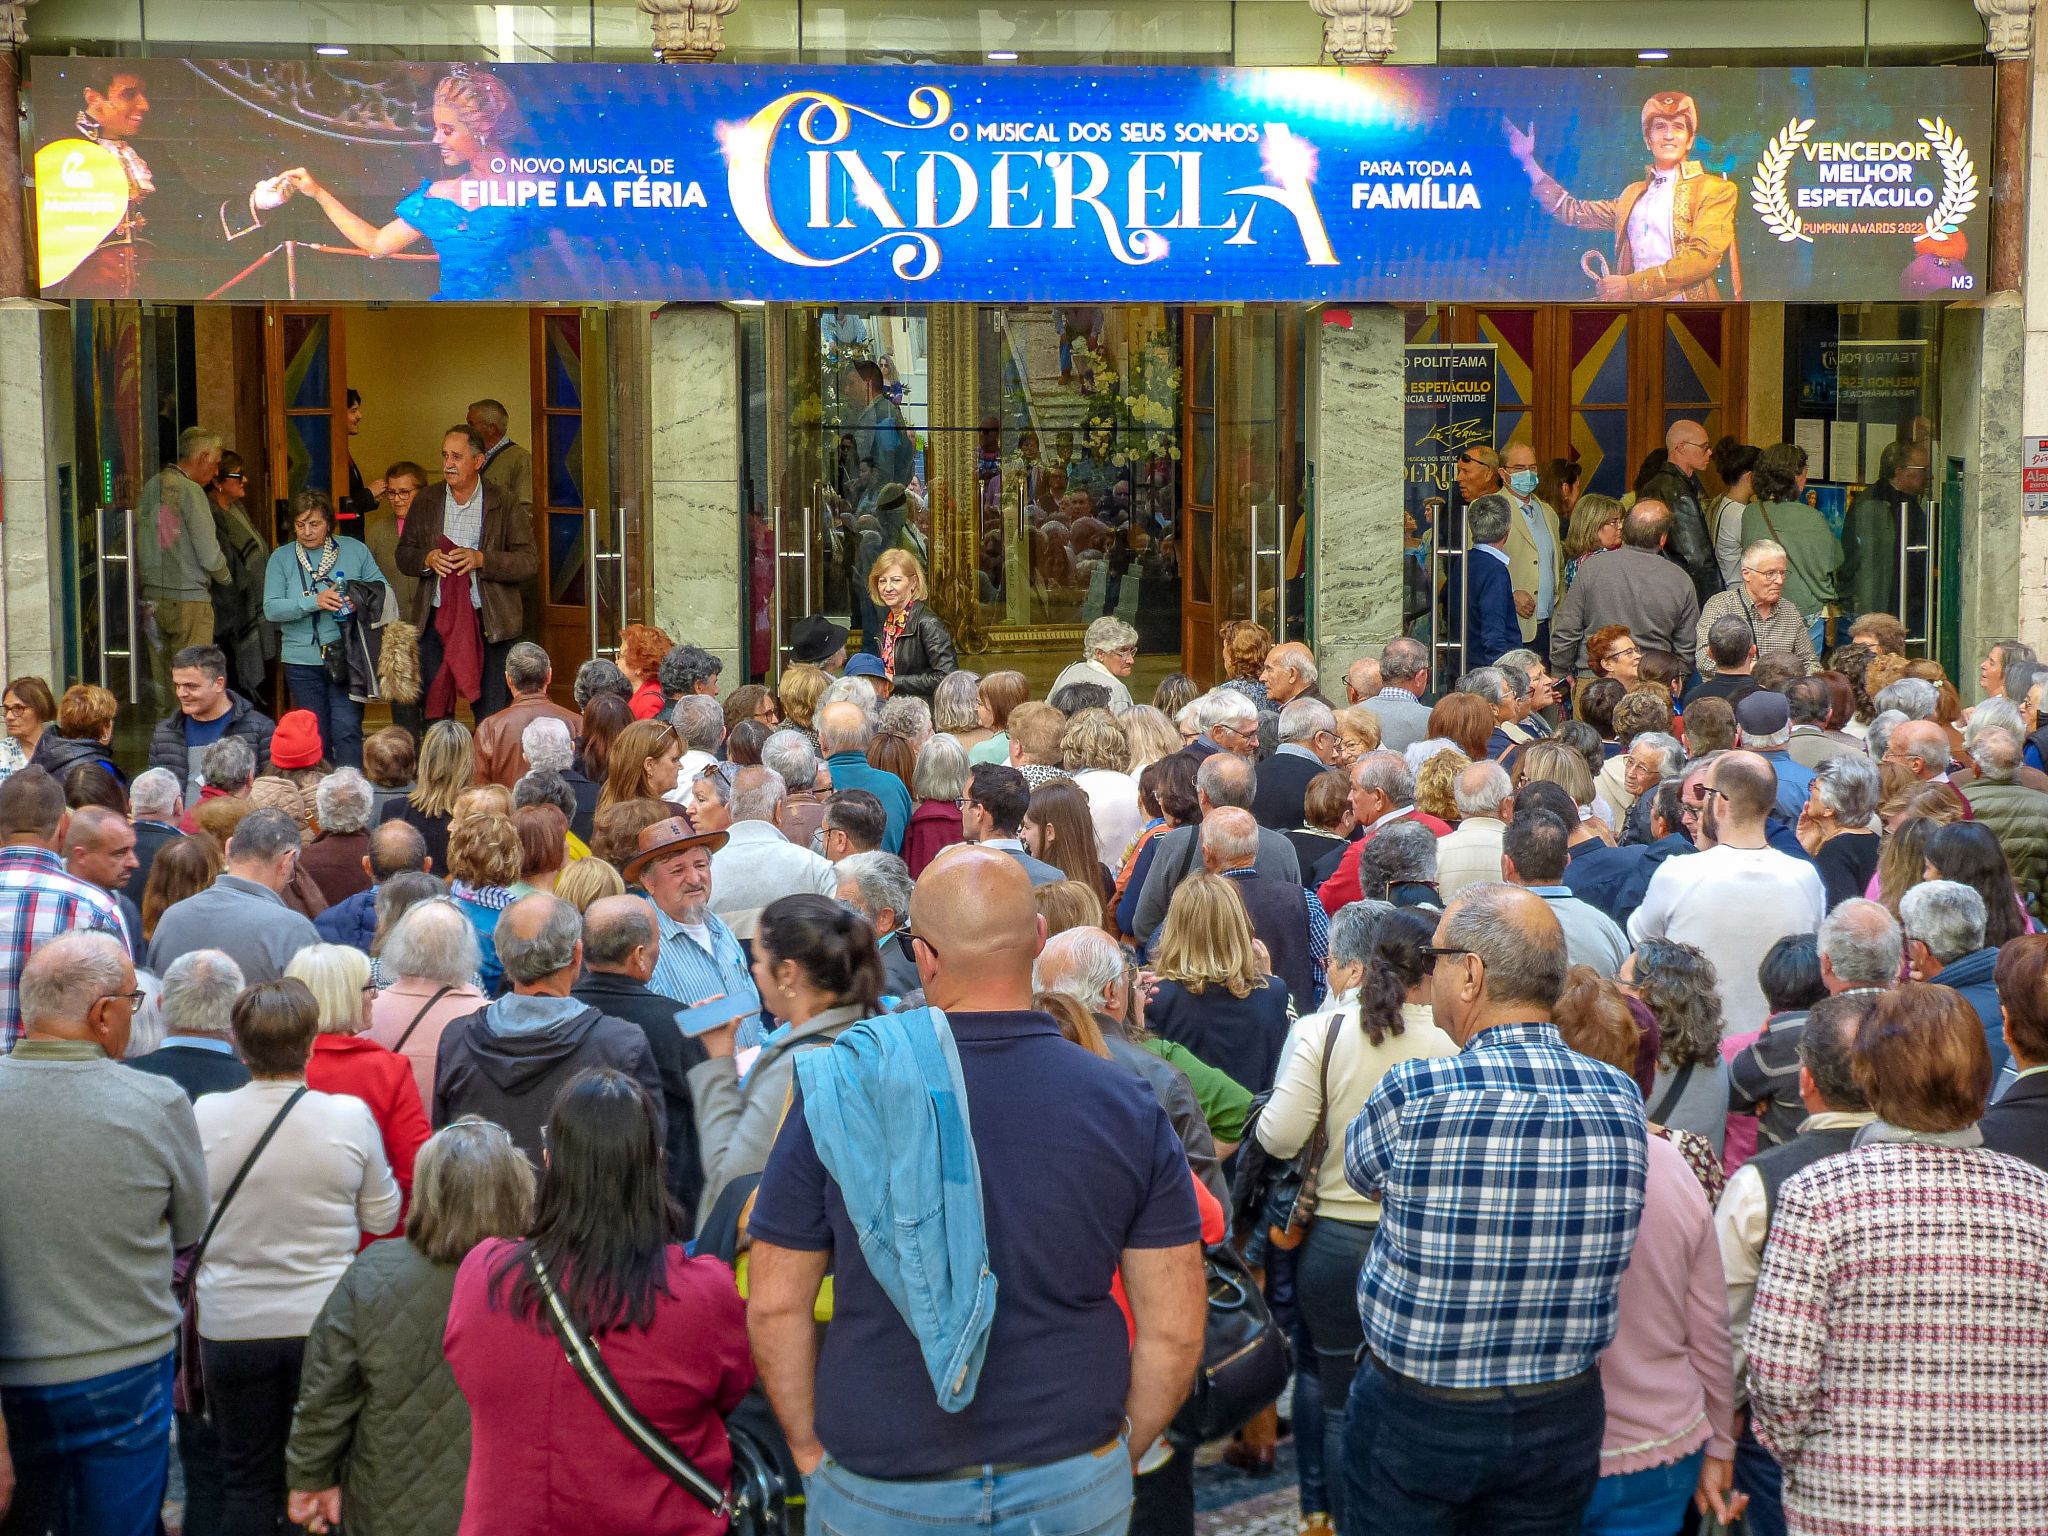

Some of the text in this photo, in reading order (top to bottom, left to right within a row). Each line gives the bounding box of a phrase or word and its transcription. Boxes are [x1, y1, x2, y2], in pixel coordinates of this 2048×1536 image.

[949, 122, 1260, 142] O MUSICAL DOS SEUS SONHOS
[1802, 142, 1930, 161] VENCEDOR
[490, 157, 675, 174] O NOVO MUSICAL DE
[1360, 161, 1472, 176] PARA TODA A
[1819, 164, 1912, 183] MELHOR
[460, 175, 708, 208] FILIPE LA FÉRIA
[727, 87, 1341, 281] CINDERELA
[1352, 177, 1481, 209] FAMÍLIA
[1797, 184, 1933, 207] ESPETÁCULO
[1803, 223, 1924, 234] PUMPKIN AWARDS 2022
[1951, 275, 1973, 289] M3
[1414, 357, 1487, 368] POLITEAMA
[1410, 379, 1491, 393] ESPETÁCULO
[1427, 395, 1433, 403] E
[1435, 394, 1487, 403] JUVENTUDE
